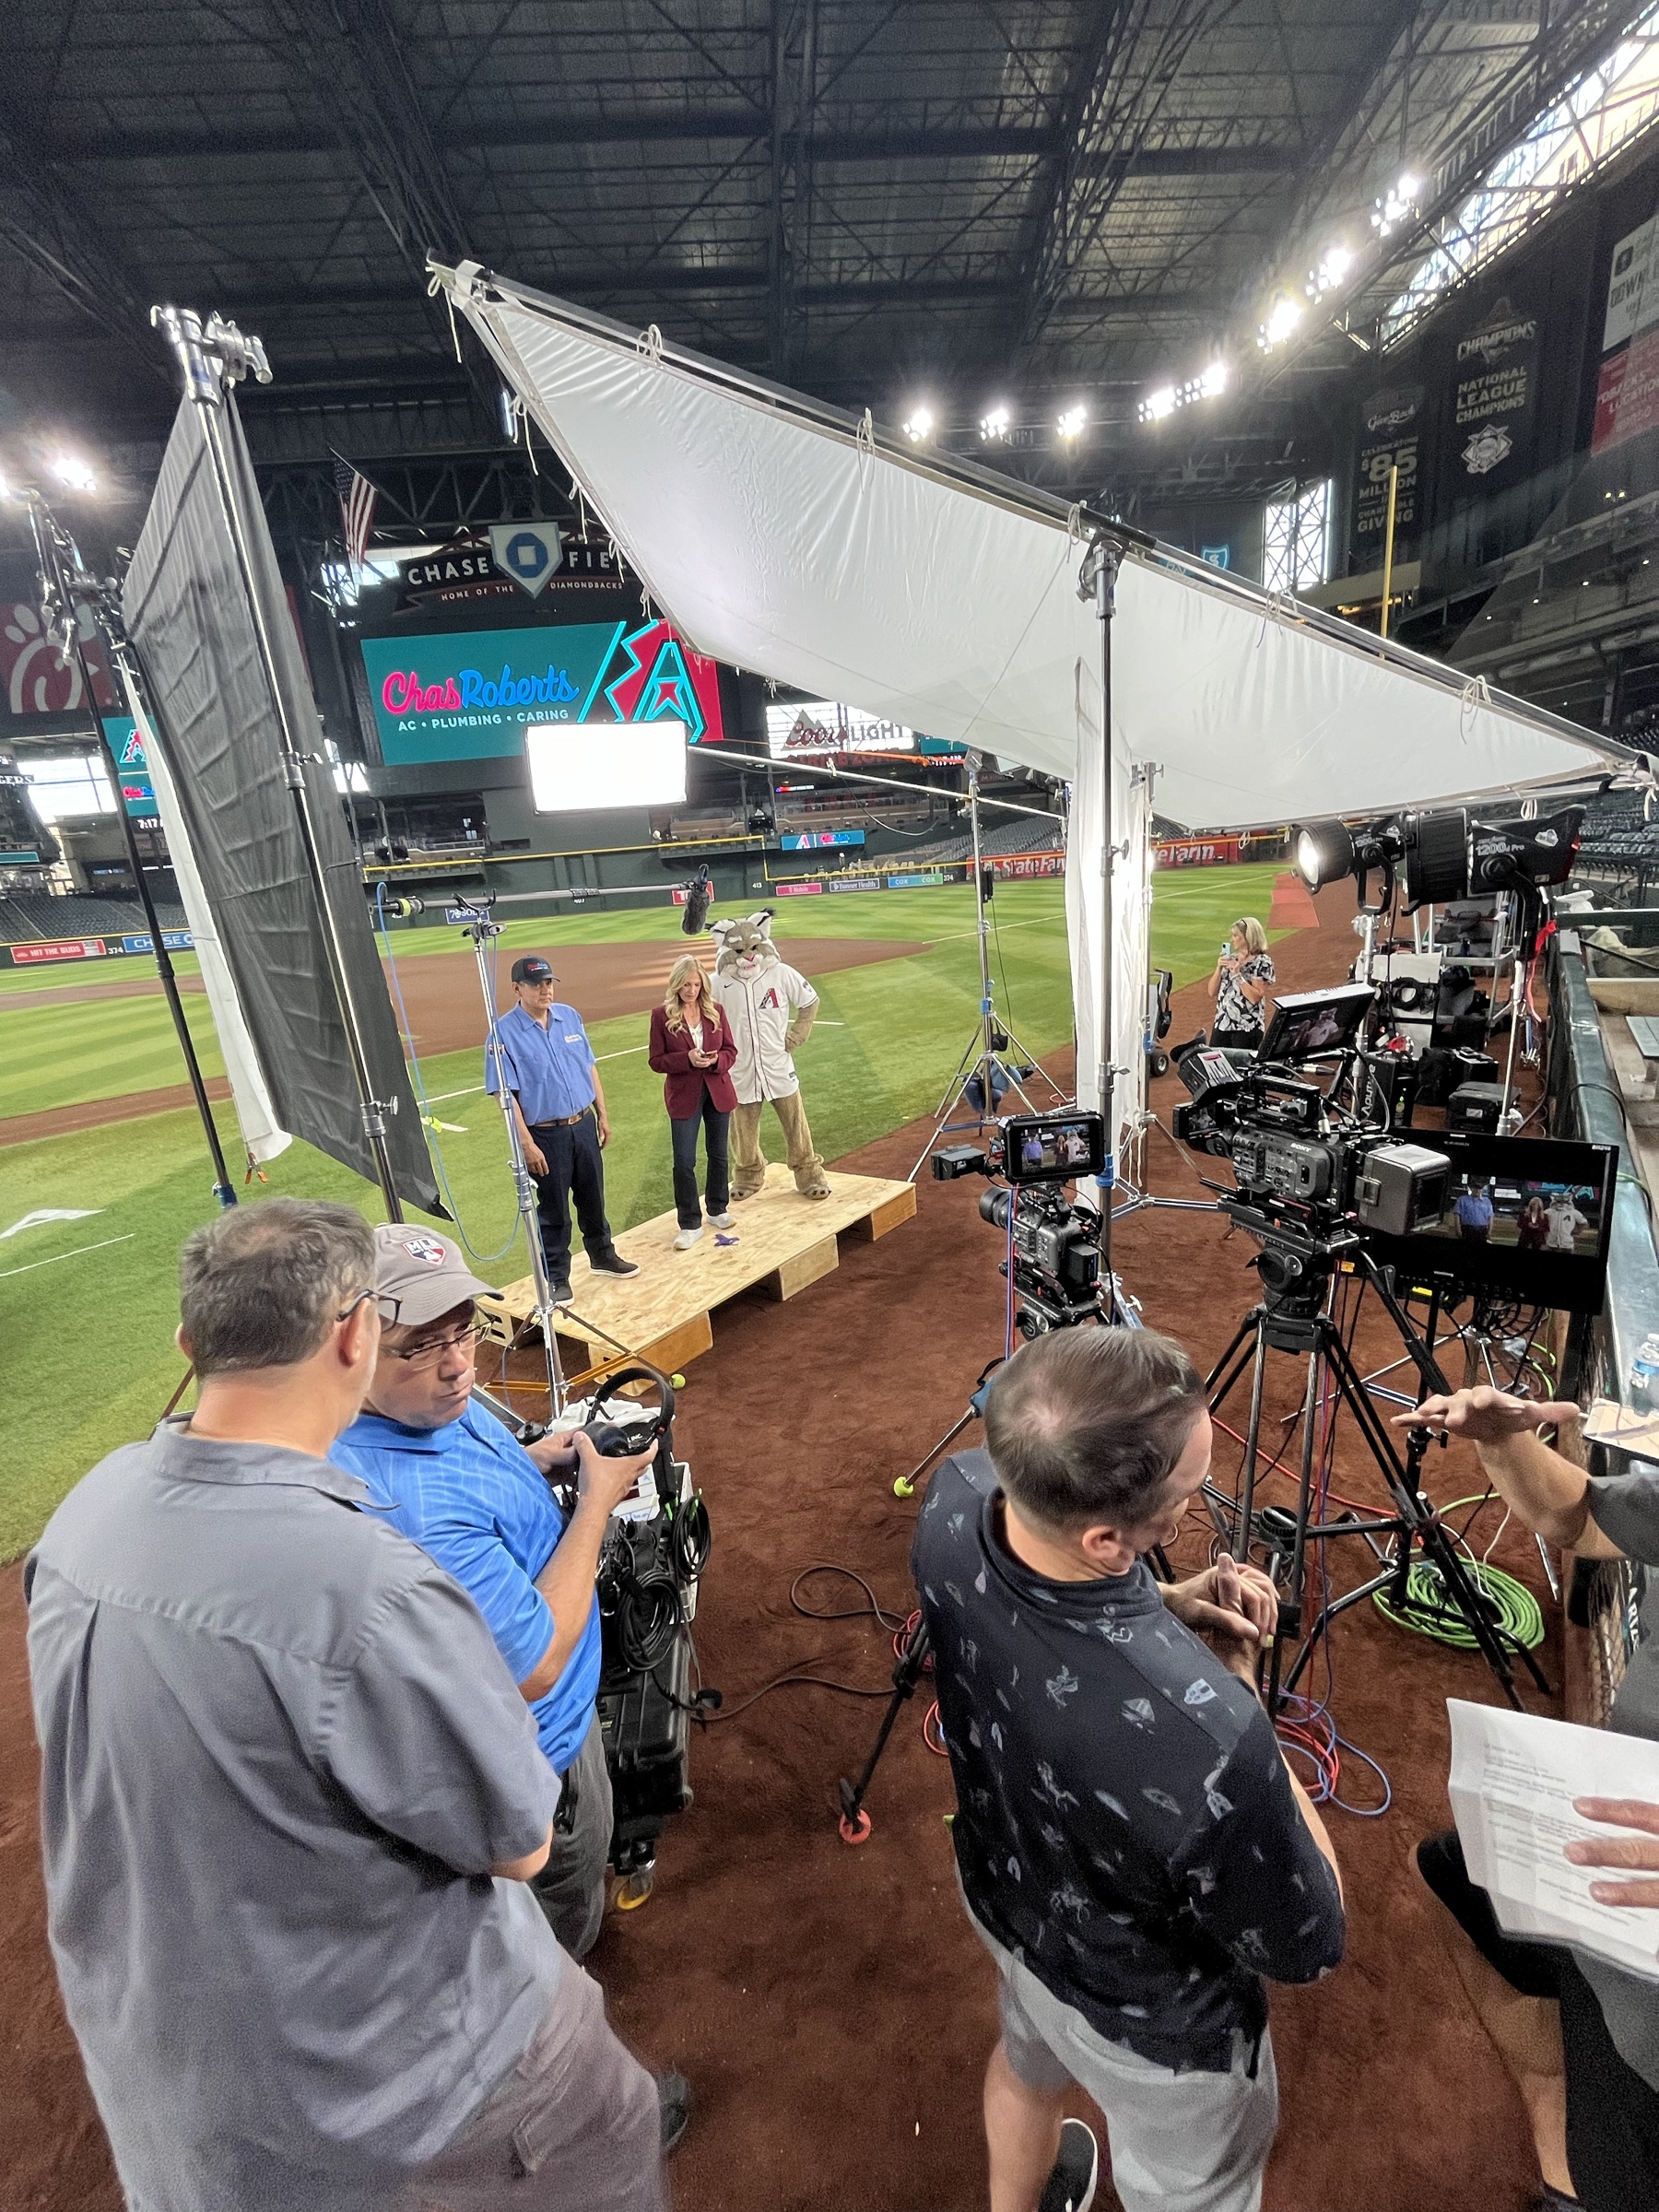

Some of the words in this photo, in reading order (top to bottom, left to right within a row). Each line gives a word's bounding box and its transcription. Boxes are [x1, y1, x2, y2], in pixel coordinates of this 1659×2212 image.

[1458, 320, 1536, 361] CHAMPIONS
[1457, 377, 1526, 408] LEAGUE
[1458, 366, 1527, 394] NATIONAL
[1456, 394, 1525, 423] CHAMPIONS
[1361, 446, 1418, 482] $85
[1359, 475, 1417, 500] MILLON
[1358, 509, 1414, 533] GIVNG
[408, 557, 488, 585] CHASE
[569, 551, 616, 569] FIE
[441, 590, 469, 601] HOME
[496, 585, 514, 594] THE
[550, 582, 623, 590] DIAMONDBACKS
[398, 721, 417, 731] AC
[431, 713, 501, 729] PLUMBING
[516, 709, 569, 722] CARING
[30, 948, 42, 957] HIT
[45, 947, 60, 955] THE
[61, 945, 82, 955] BUDS
[135, 935, 181, 948] CHSE
[1290, 1143, 1312, 1152] SONY
